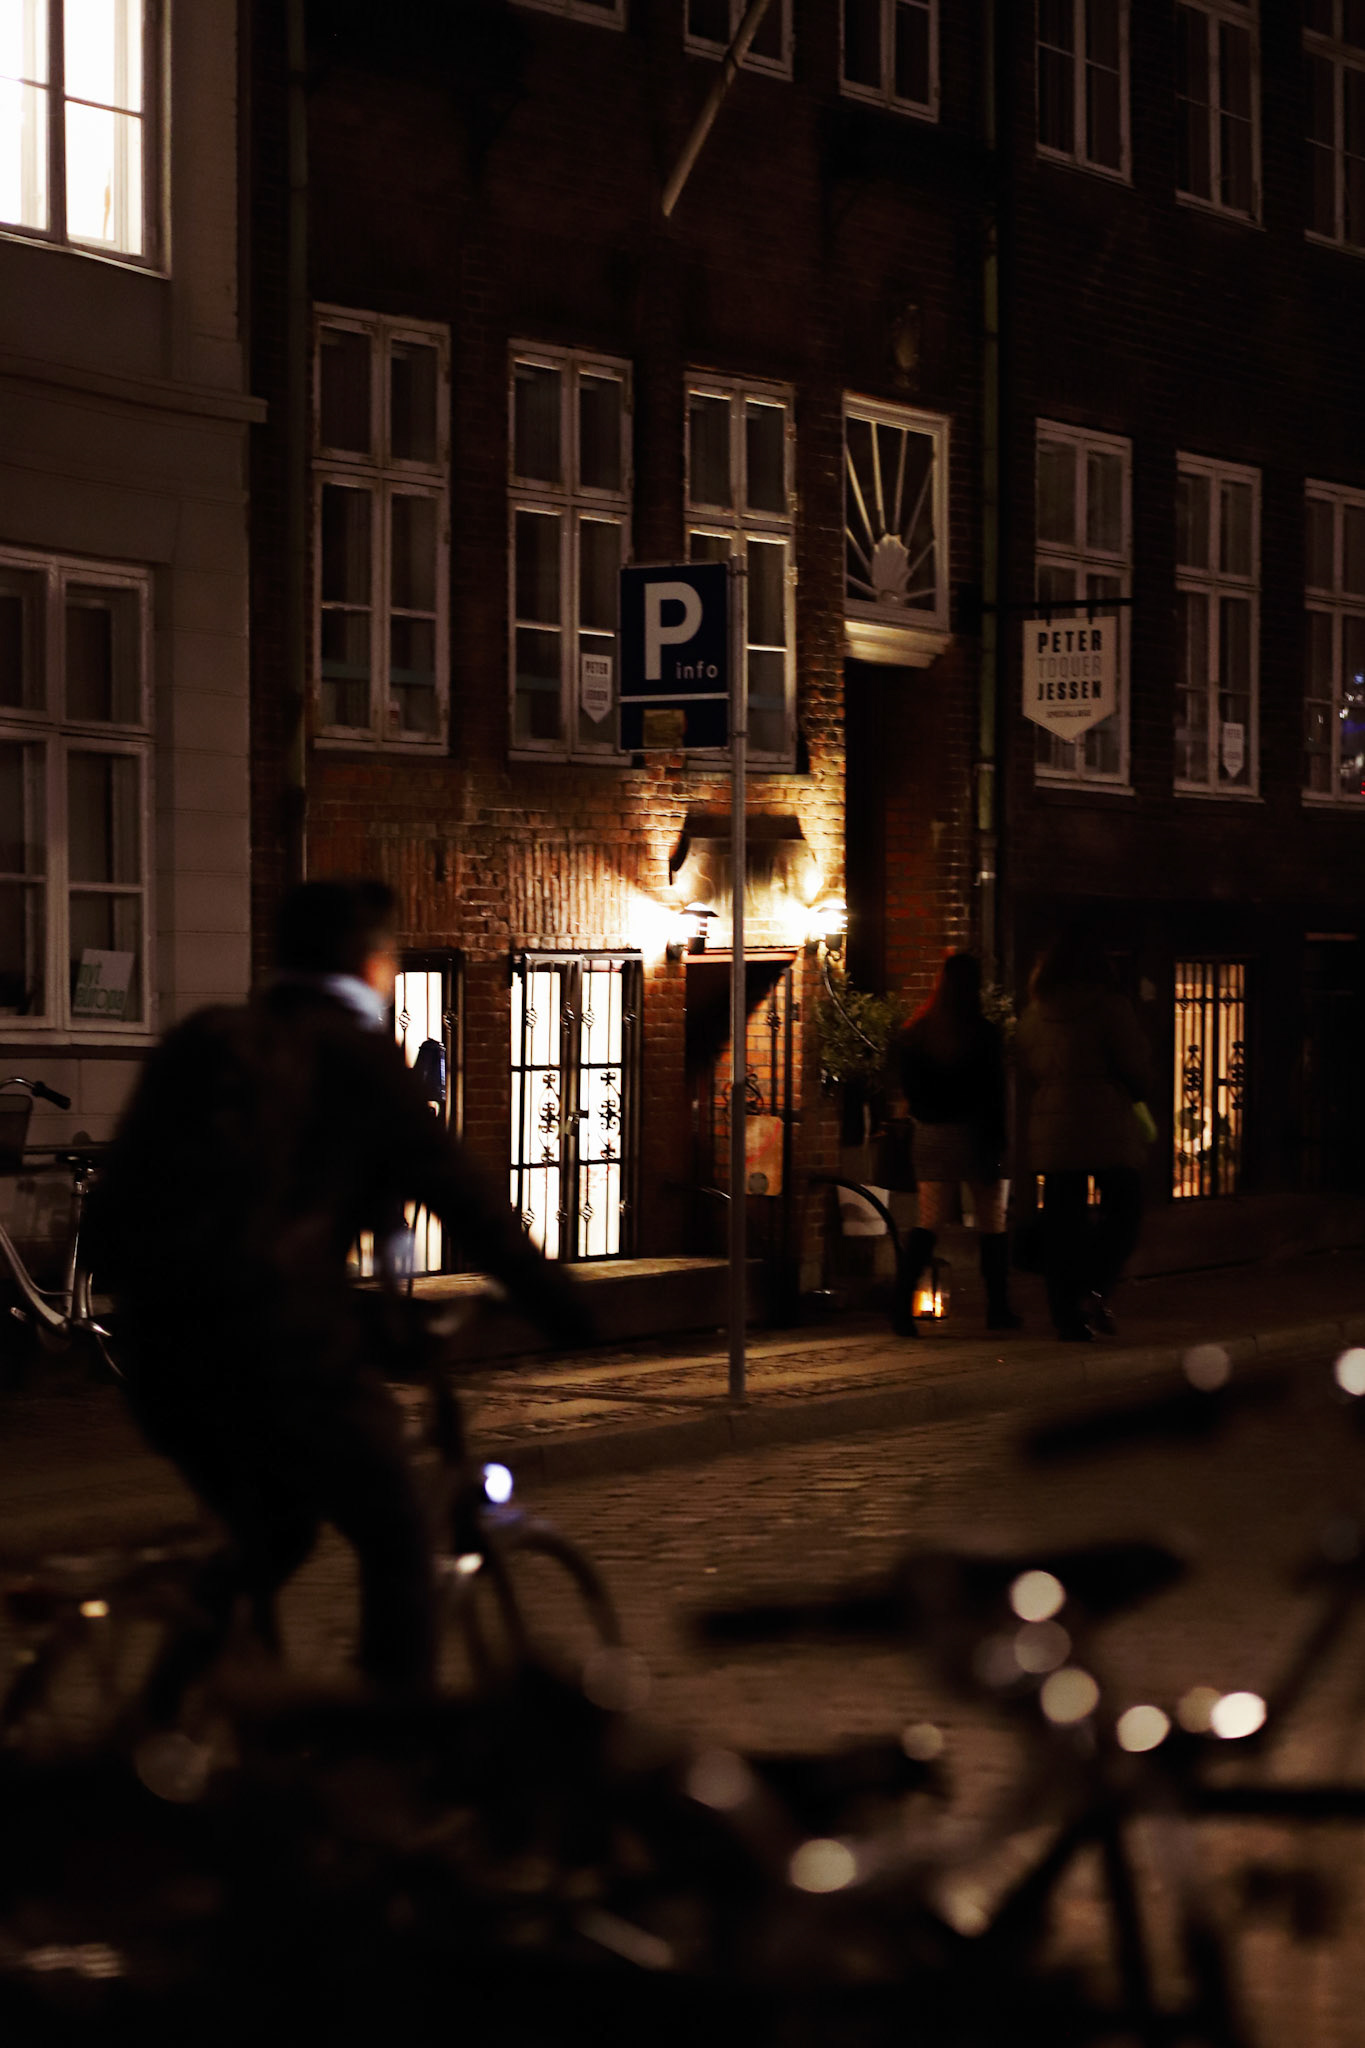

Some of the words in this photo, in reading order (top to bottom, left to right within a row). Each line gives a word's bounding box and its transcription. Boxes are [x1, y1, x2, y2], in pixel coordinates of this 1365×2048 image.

[644, 581, 703, 680] P
[1037, 630, 1102, 653] PETER
[675, 661, 718, 680] info
[1037, 656, 1102, 678] TOQUER
[1037, 681, 1102, 701] JESSEN
